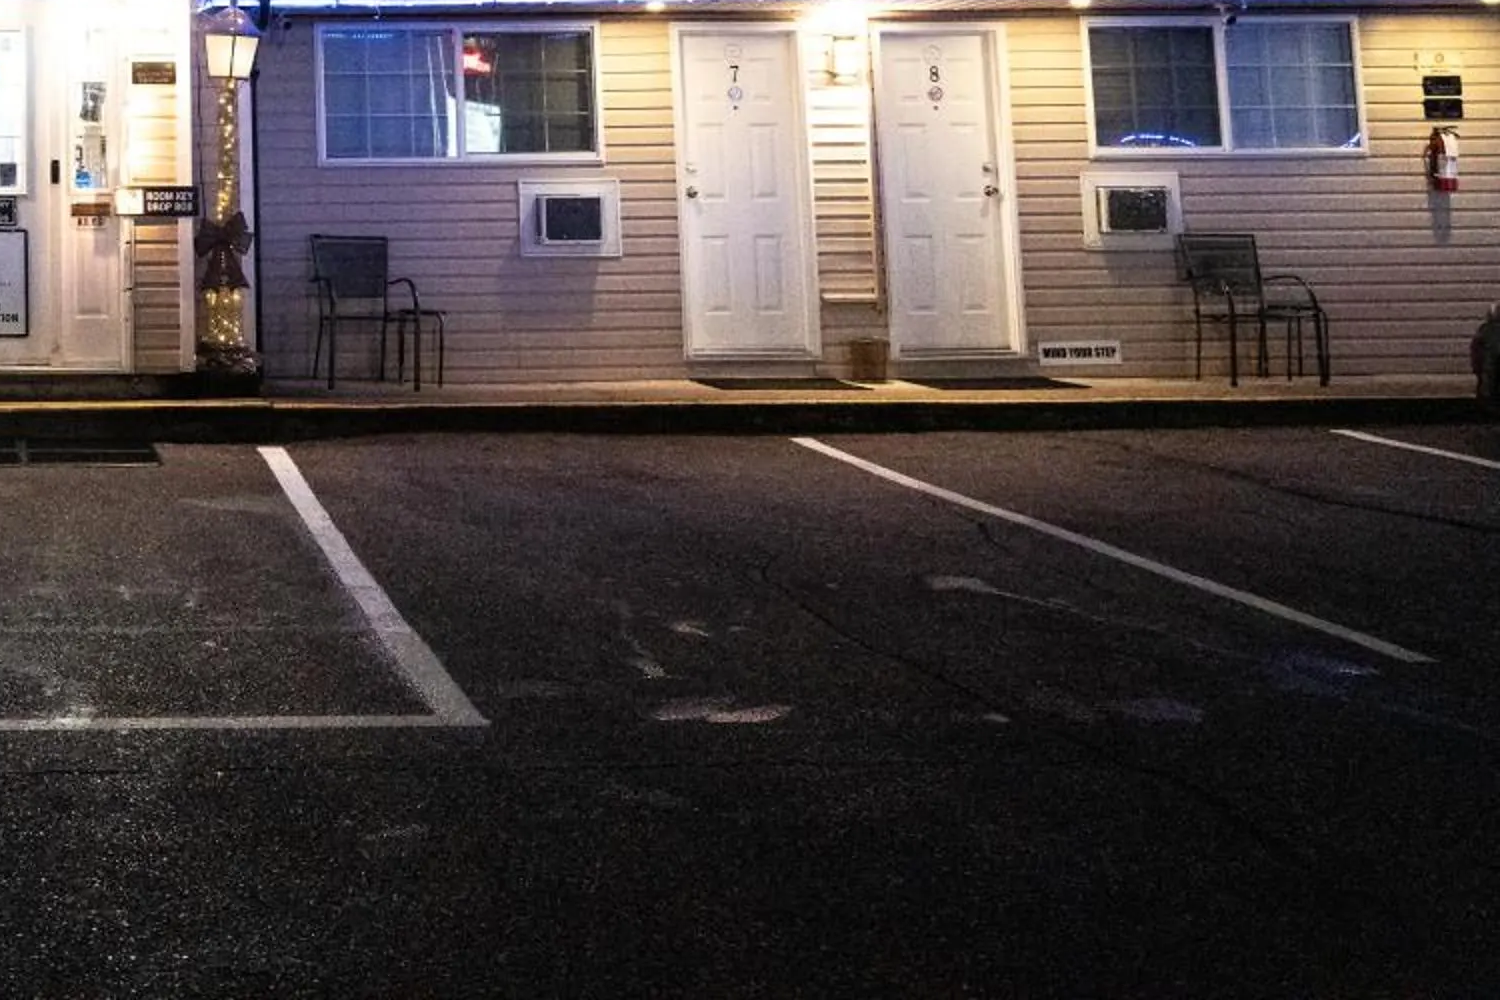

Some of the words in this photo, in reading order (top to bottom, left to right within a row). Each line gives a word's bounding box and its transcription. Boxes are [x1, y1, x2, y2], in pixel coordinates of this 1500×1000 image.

[729, 64, 739, 83] 7
[929, 65, 940, 83] 8
[146, 191, 174, 201] ROOM
[175, 191, 194, 201] KEY
[147, 202, 173, 212] DROP
[1042, 347, 1067, 359] MIND
[1068, 347, 1093, 358] YOUR
[1094, 346, 1117, 358] STEP
